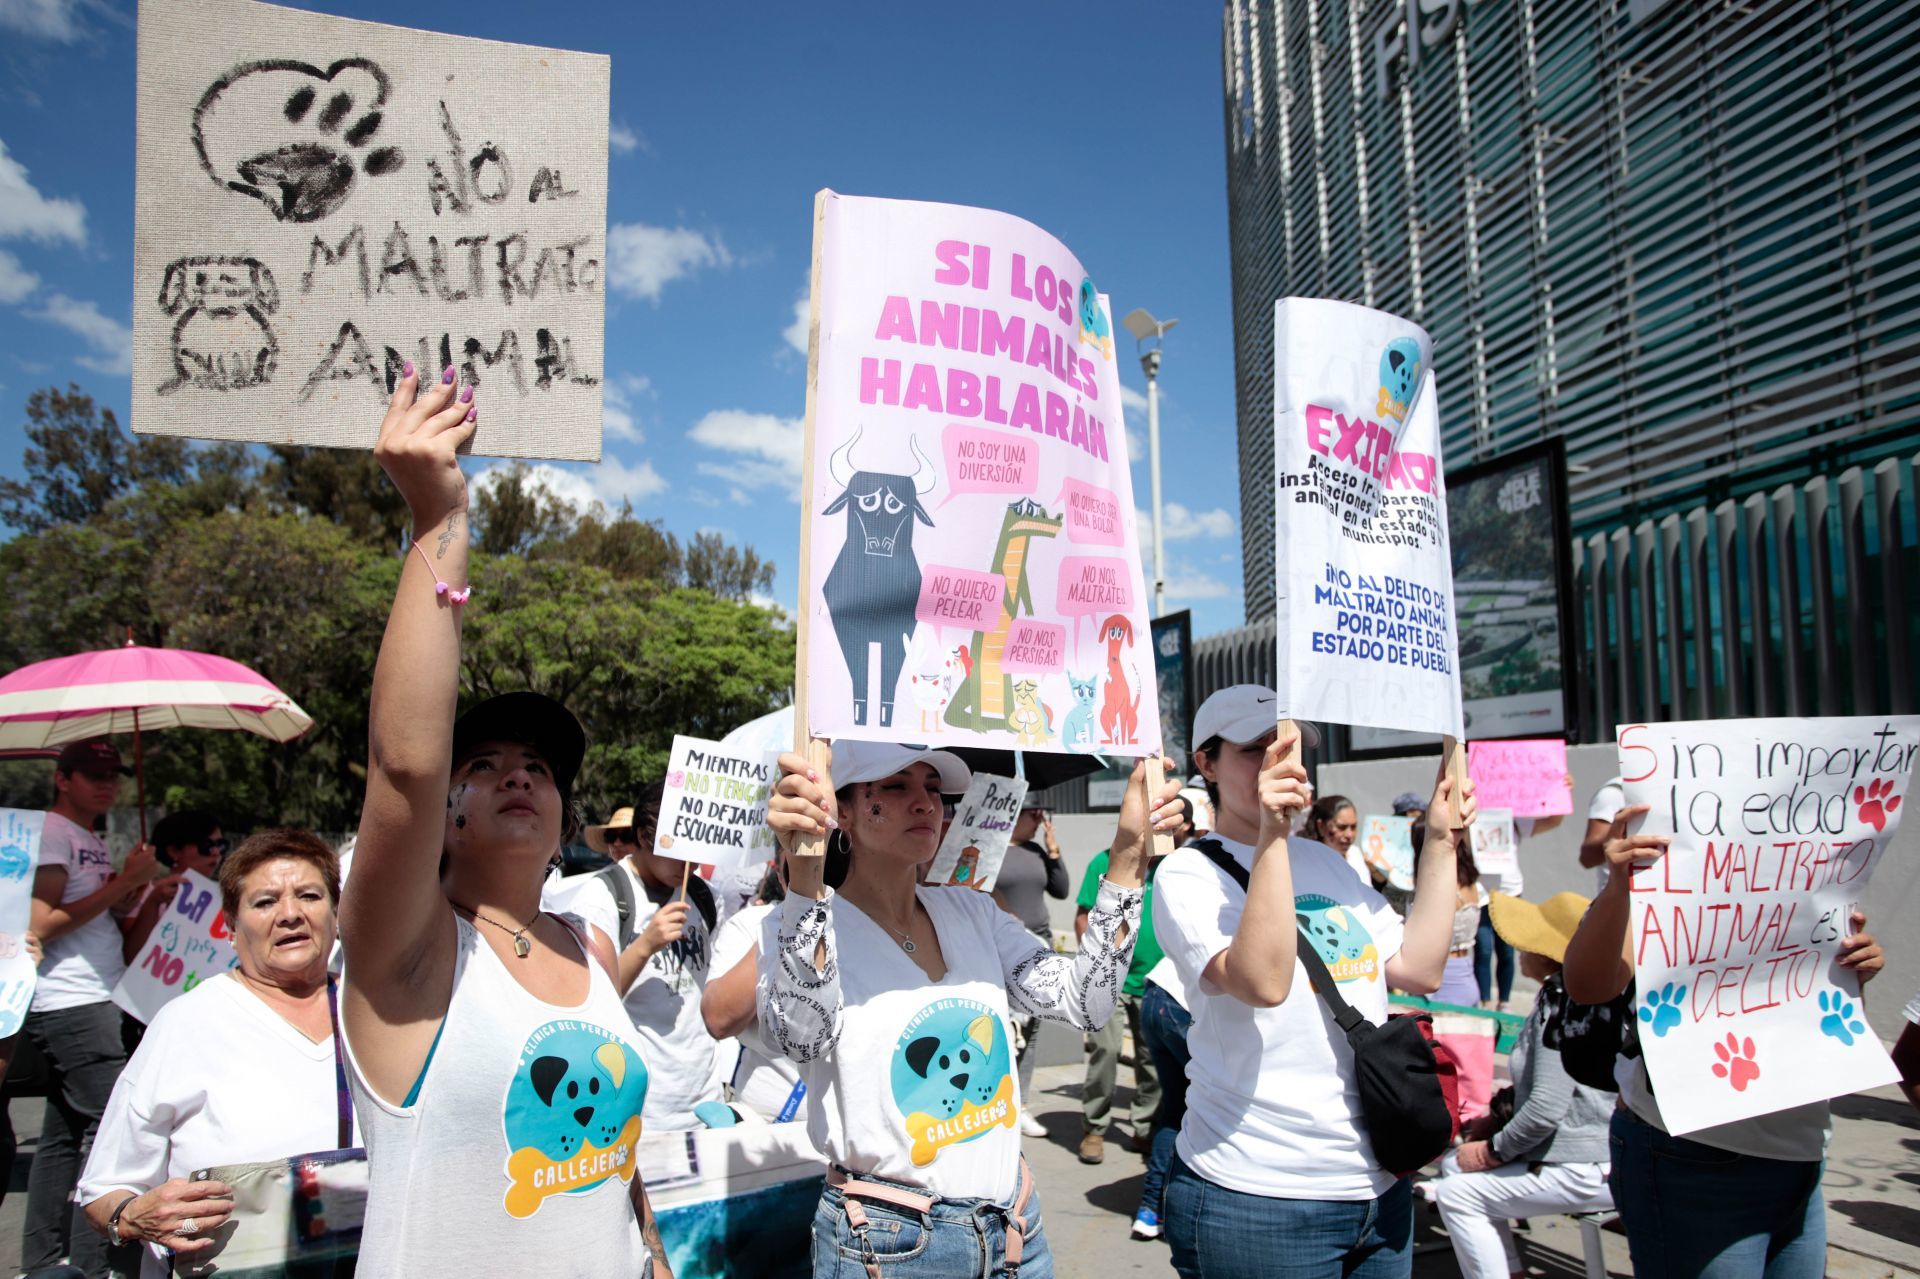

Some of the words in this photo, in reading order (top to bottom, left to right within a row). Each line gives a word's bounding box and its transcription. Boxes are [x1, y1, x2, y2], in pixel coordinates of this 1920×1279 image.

[301, 221, 597, 305] MALTRATO
[935, 240, 990, 290] SI
[1011, 253, 1073, 326] LOS
[875, 296, 1098, 400] ANIMALES
[860, 357, 1109, 463] HABLARÁN
[957, 441, 974, 458] NO
[978, 442, 1000, 461] SOY
[1003, 444, 1026, 463] UNA
[959, 462, 1024, 485] DIVERSIÓN.
[1308, 454, 1358, 488] Acceso
[1069, 491, 1080, 508] NO
[1081, 495, 1107, 517] QUIERO
[1074, 509, 1090, 529] UNA
[1344, 510, 1358, 526] en
[1361, 517, 1373, 531] el
[1379, 519, 1427, 537] estado
[931, 575, 950, 595] NO
[954, 579, 997, 602] QUIERO
[1081, 565, 1096, 584] NO
[1099, 567, 1116, 586] NOS
[934, 597, 984, 622] PELEAR.
[1315, 584, 1406, 620] MALTRATO
[1409, 605, 1448, 636] ANIMA
[1358, 575, 1382, 593] AL
[1384, 575, 1432, 606] DELITO
[1433, 591, 1446, 612] DE
[1016, 628, 1033, 644] NO
[1037, 630, 1055, 647] NOS
[1337, 611, 1373, 637] POR
[1377, 618, 1424, 646] PARTE
[1427, 630, 1447, 653] DEL
[1312, 632, 1384, 661] ESTADO
[1388, 644, 1408, 666] DE
[1412, 648, 1451, 675] PUEBL
[685, 749, 769, 782] MIENTRAS
[1618, 724, 1723, 782] Sin
[1755, 723, 1918, 786] importar
[684, 771, 709, 794] NO
[679, 796, 703, 815] NO
[961, 806, 975, 828] la
[1670, 785, 1724, 837] la
[1742, 780, 1854, 836] edad
[673, 815, 744, 848] ESCUCHAR
[1628, 844, 1692, 894] EL
[1703, 838, 1875, 894] MALTRATO
[176, 881, 213, 924] LA
[1638, 902, 1800, 968] ANIMAL
[141, 944, 184, 987] NO
[797, 979, 821, 989] LOVE
[1692, 950, 1821, 1023] DELITO
[937, 999, 955, 1011] DEL
[957, 999, 989, 1014] PERRO
[557, 1021, 578, 1032] DEL
[580, 1022, 616, 1042] PERRO
